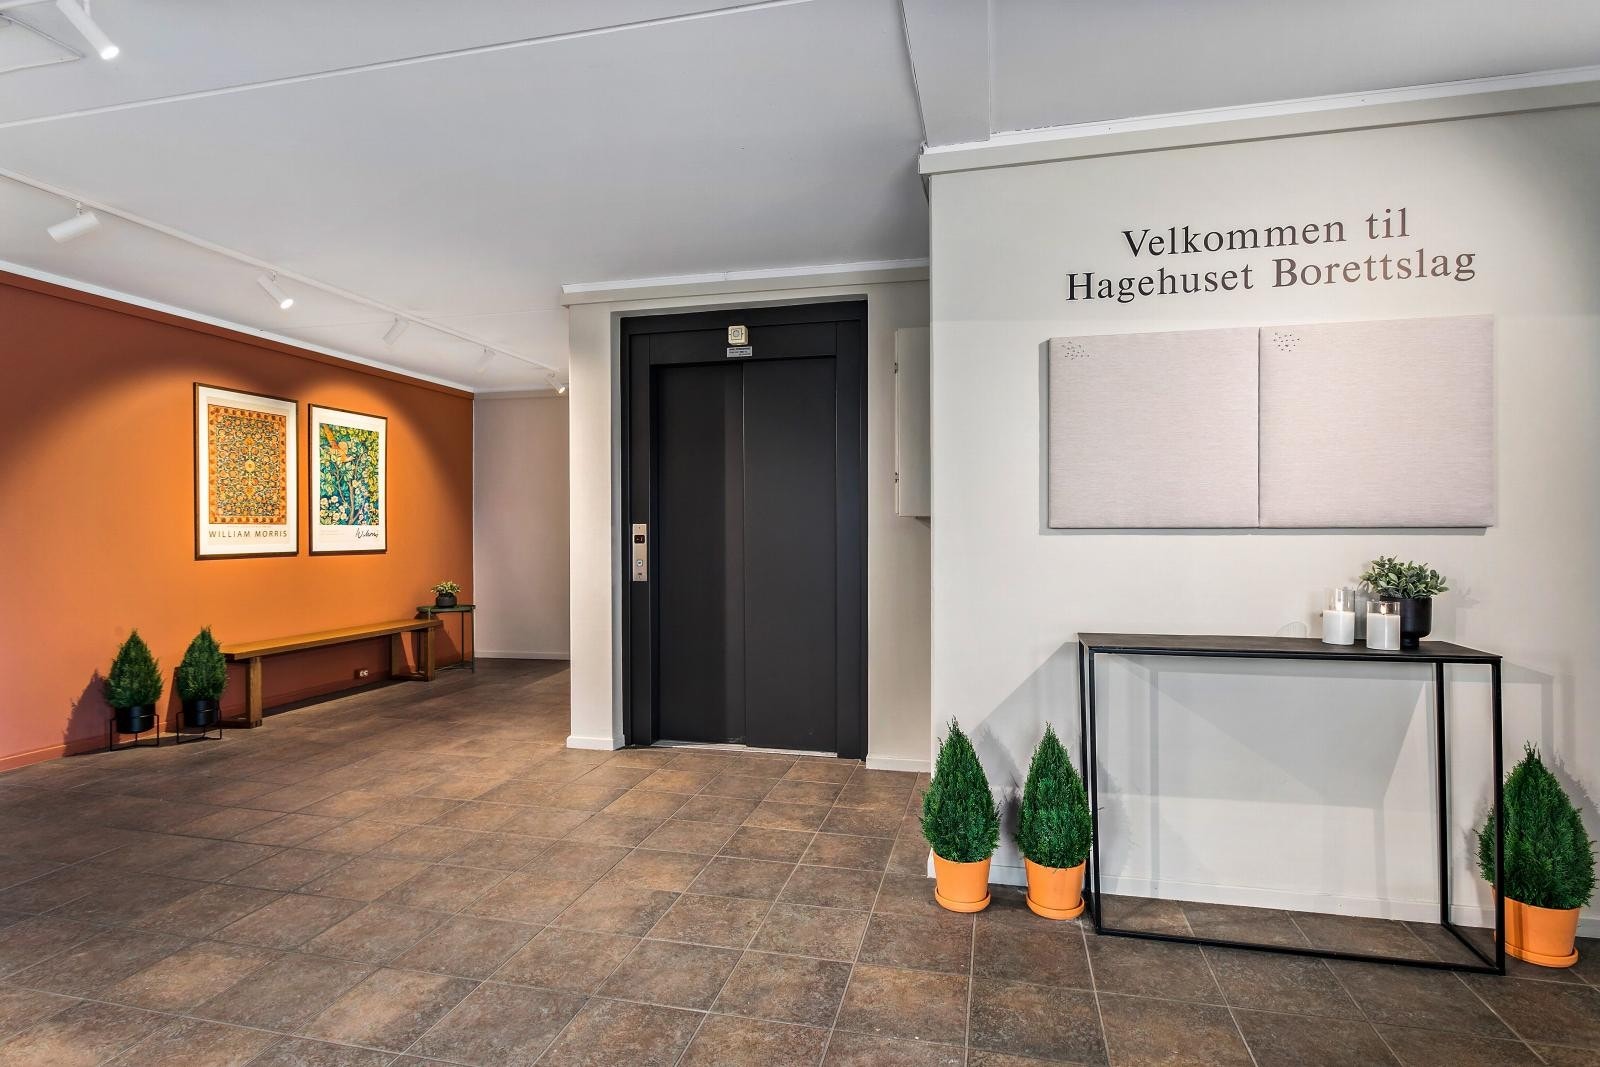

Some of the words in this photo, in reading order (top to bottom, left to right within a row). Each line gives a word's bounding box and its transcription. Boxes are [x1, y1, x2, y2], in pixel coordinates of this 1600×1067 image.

[1122, 217, 1347, 258] Velkommen
[1365, 207, 1411, 240] til
[1065, 263, 1255, 304] Hagehuset
[1271, 248, 1477, 289] Borettslag
[208, 530, 251, 538] WILLIAM
[254, 530, 288, 538] MORRIS
